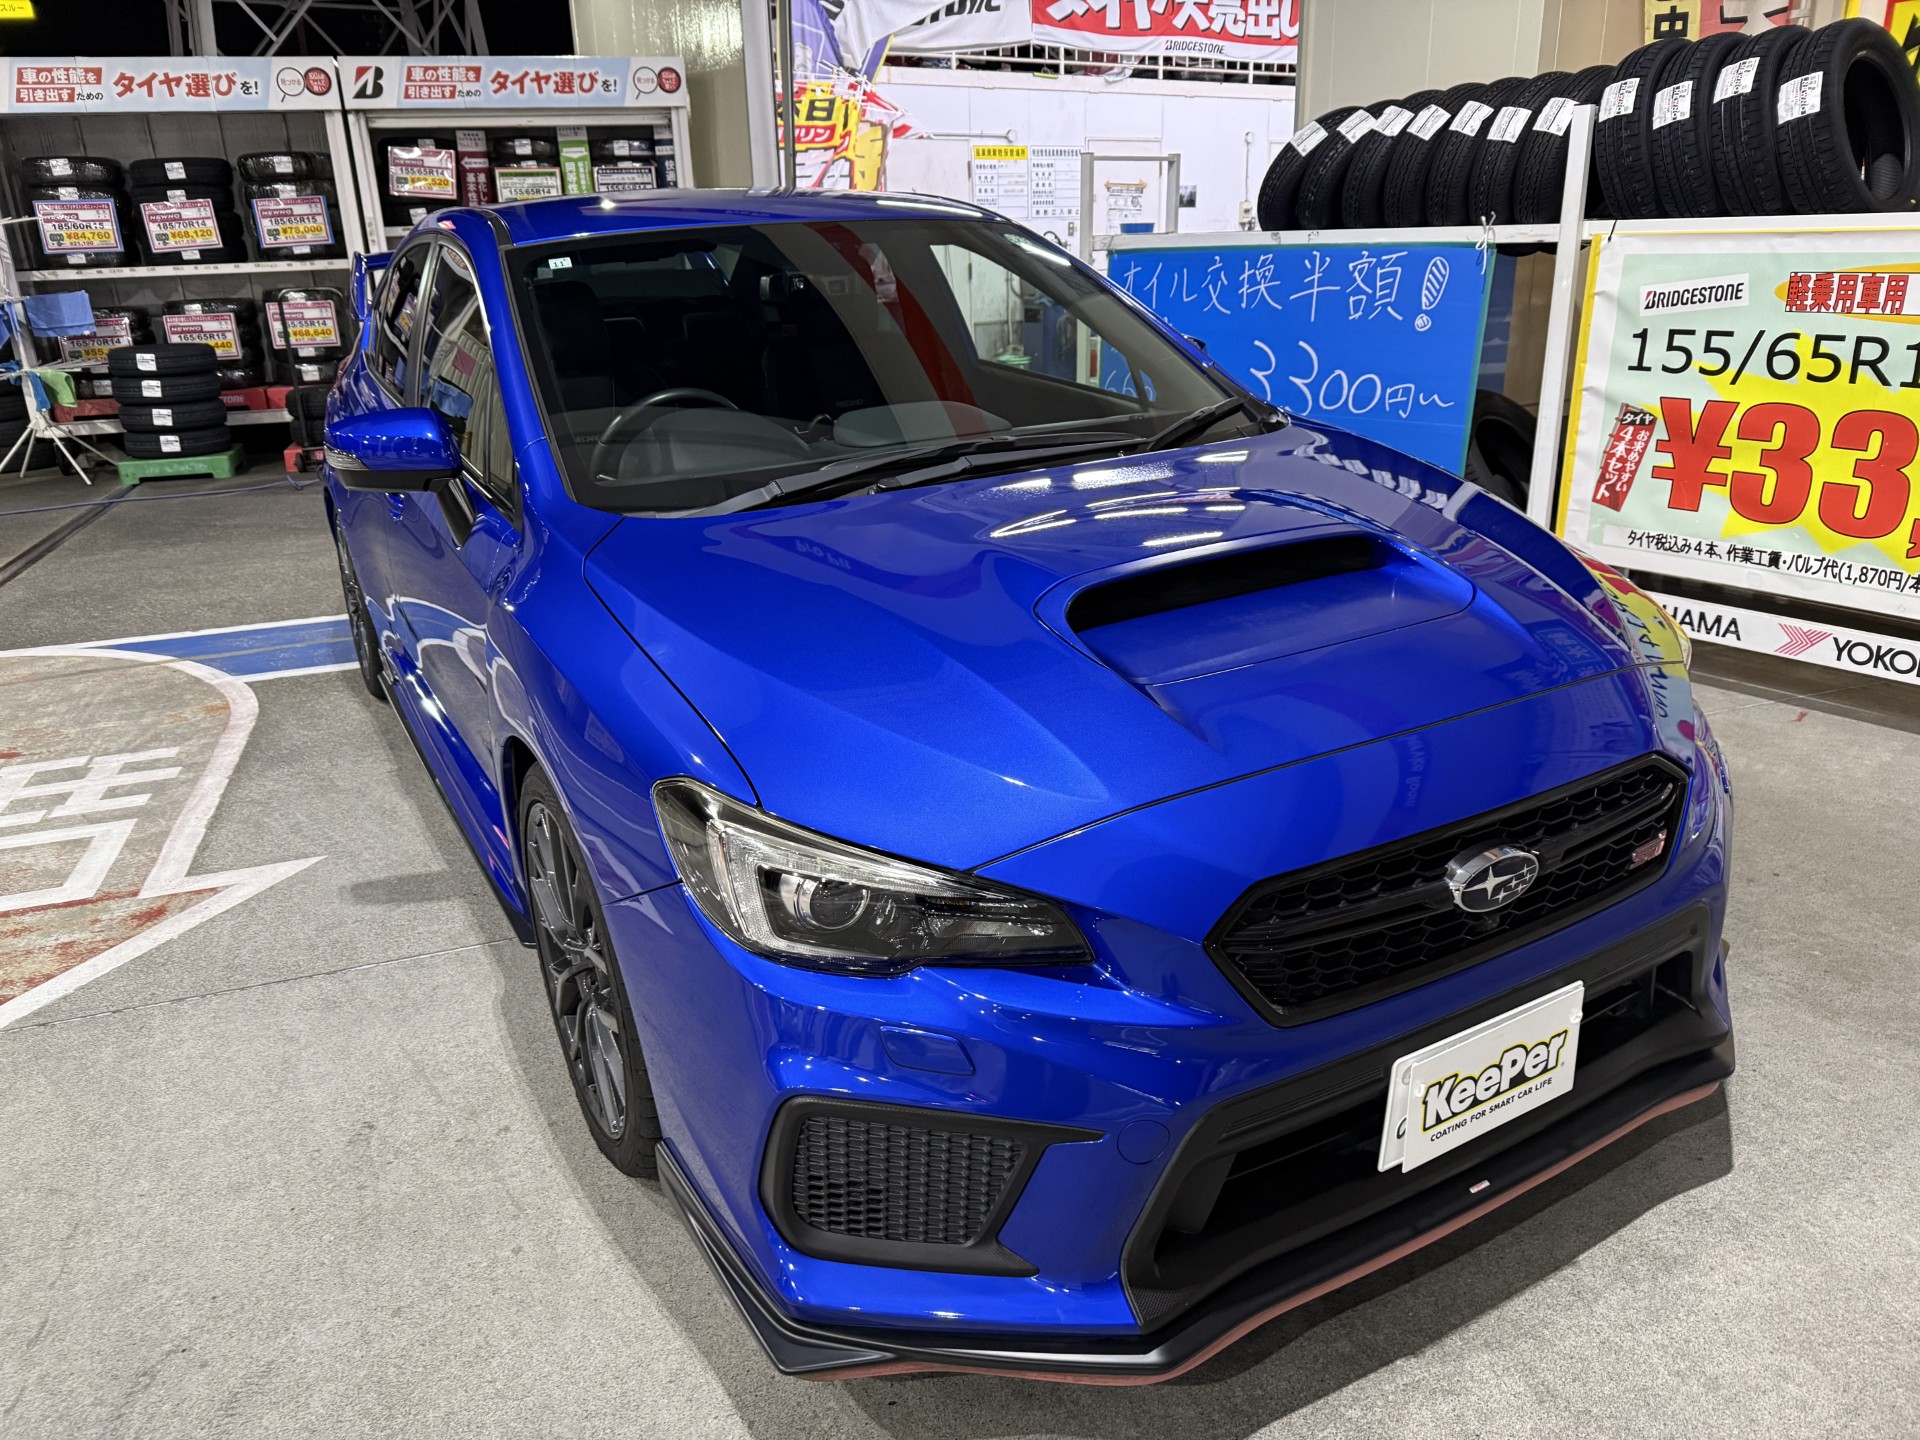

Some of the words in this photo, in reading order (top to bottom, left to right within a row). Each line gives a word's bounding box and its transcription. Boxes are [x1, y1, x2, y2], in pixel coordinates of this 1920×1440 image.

[1165, 40, 1225, 55] BRIDGESTONE
[21, 68, 97, 84] 車の性能を
[410, 67, 477, 81] 車の性能を
[157, 220, 208, 230] 185/70R14
[268, 216, 318, 226] 185/65R15
[65, 232, 112, 241] ¥84,760
[169, 229, 213, 240] ¥68,120
[280, 225, 324, 236] ¥78,000
[1644, 282, 1746, 310] BRIDGESTONE
[1786, 272, 1910, 315] 軽乗用車用
[291, 329, 332, 338] ¥68,640
[1622, 411, 1655, 429] タイヤ
[1595, 426, 1634, 502] 4本セット
[1615, 429, 1650, 493] お求めやすい
[1833, 636, 1920, 677] YOKO
[1422, 1028, 1568, 1133] KeePer
[1430, 1118, 1467, 1142] COATING
[1470, 1109, 1486, 1123] FOR
[1489, 1094, 1517, 1114] SMART
[1517, 1086, 1533, 1100] CAR
[1534, 1076, 1552, 1091] LIFE
